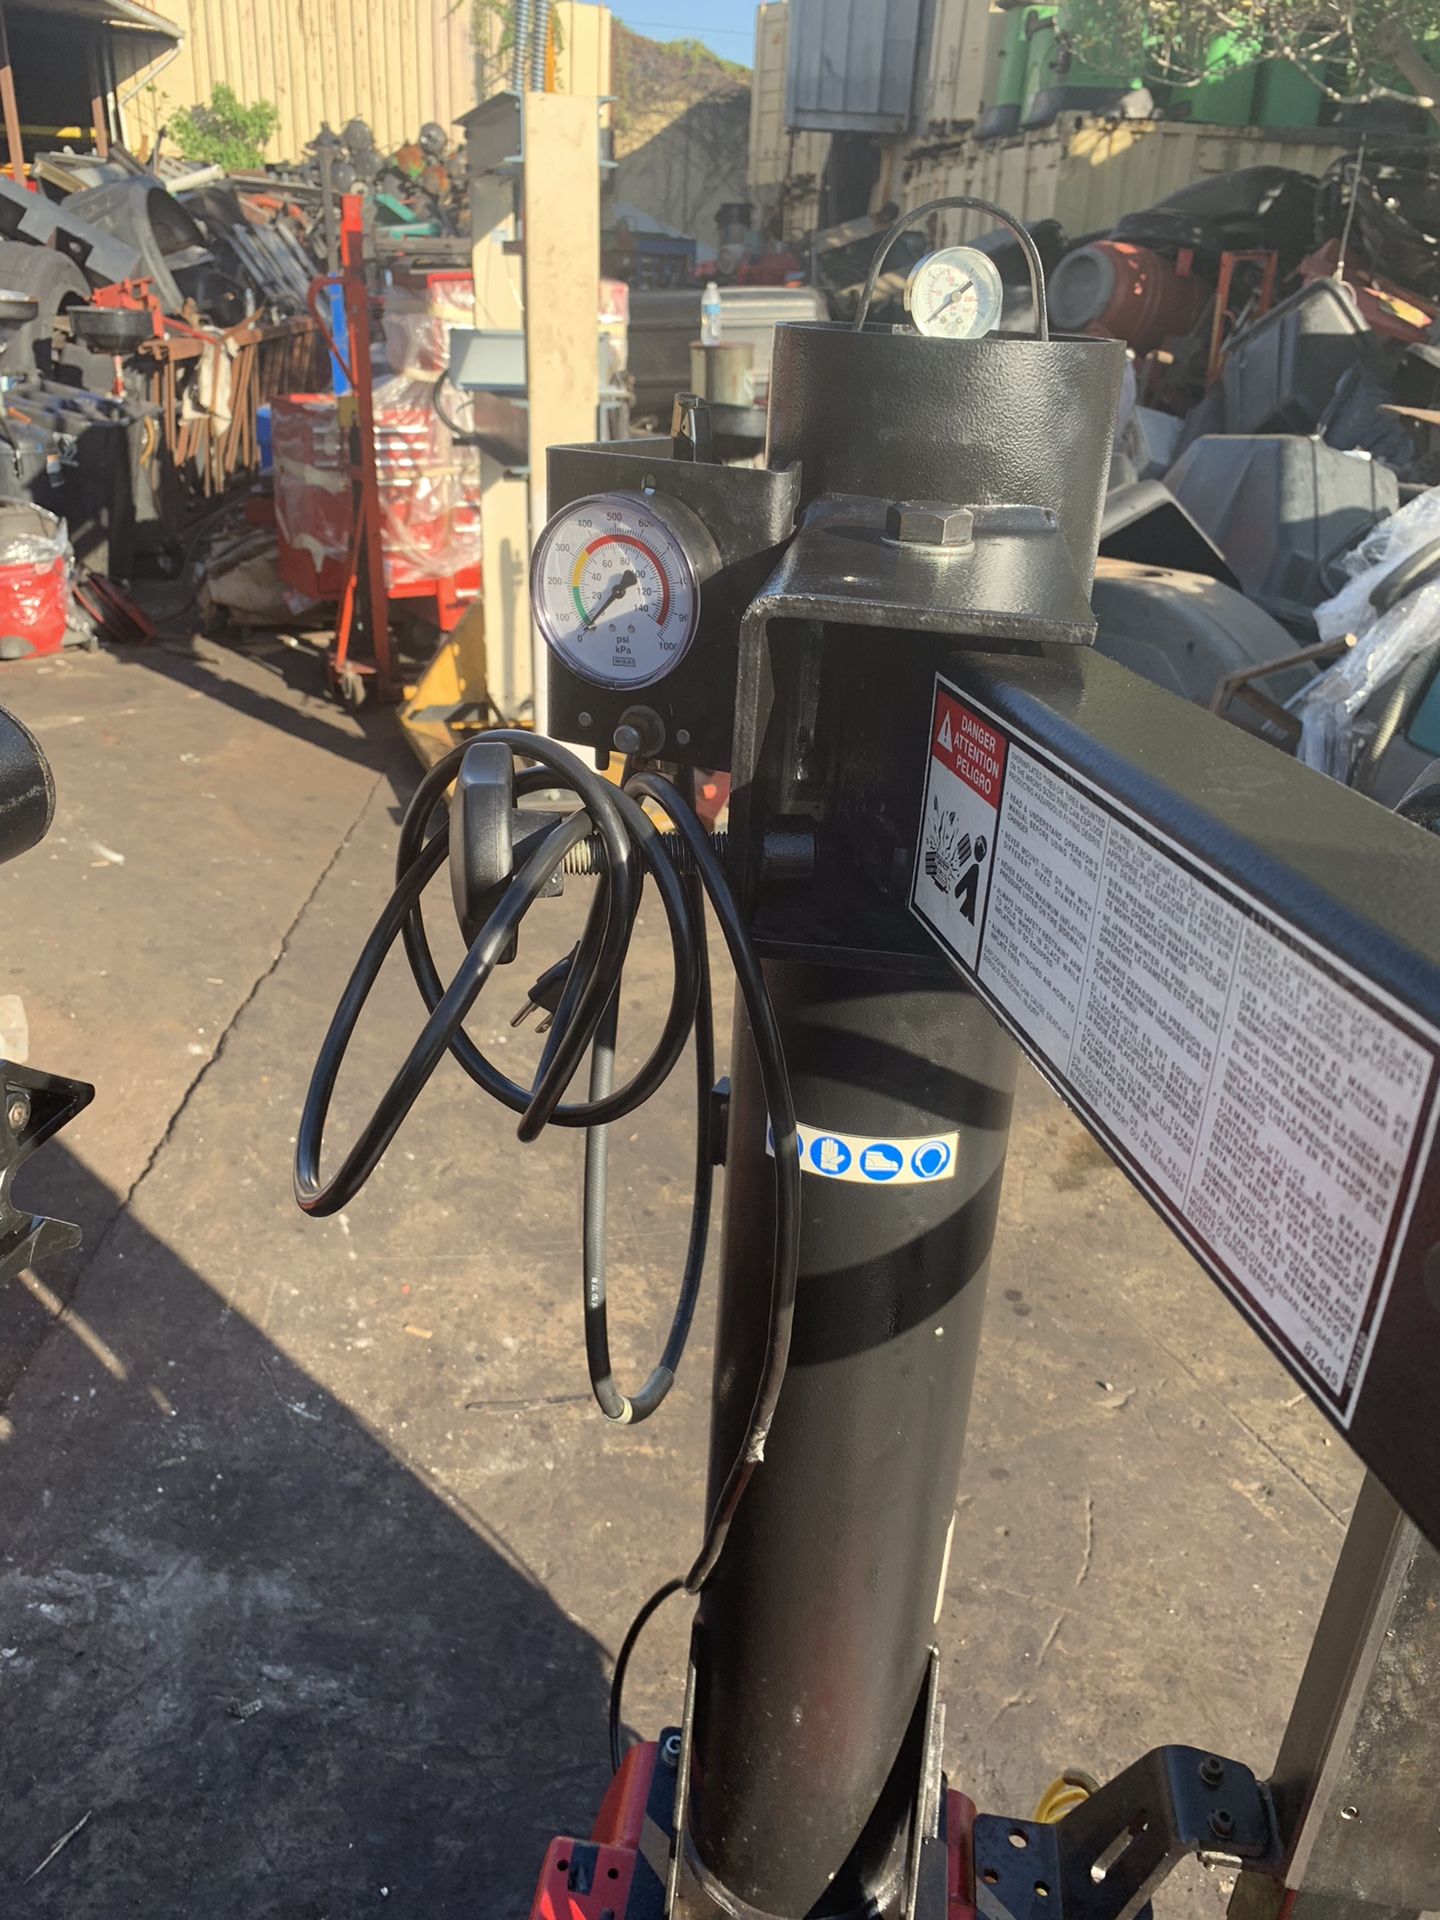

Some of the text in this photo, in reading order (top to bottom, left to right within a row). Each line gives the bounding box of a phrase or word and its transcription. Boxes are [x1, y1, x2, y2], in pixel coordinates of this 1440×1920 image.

[606, 513, 622, 521] 500
[578, 519, 592, 528] 400
[555, 544, 570, 552] 300
[602, 559, 613, 568] 60
[620, 557, 630, 566] 80
[548, 577, 562, 585] 200
[592, 573, 602, 582] 40
[592, 592, 602, 600] 20
[637, 587, 652, 596] 120
[634, 604, 649, 612] 140
[556, 613, 570, 622] 100
[577, 634, 583, 643] 0
[616, 636, 630, 646] psi
[615, 646, 632, 655] kPa
[961, 715, 996, 754] DANGER
[954, 732, 1000, 779] ATTENTION
[956, 754, 992, 794] PELIGRO
[1002, 839, 1031, 871] DIFFERENT
[1033, 866, 1051, 889] SIZED
[1004, 829, 1019, 850] NEVER
[1020, 844, 1039, 867] MOUNT
[1040, 861, 1052, 879] TIRE
[1064, 882, 1075, 899] RIM
[1077, 893, 1092, 914] WITH
[1107, 876, 1123, 896] BIEN
[1124, 890, 1155, 923] PRENDRE
[1157, 917, 1214, 971] CONNAISSANCE
[1110, 919, 1133, 946] JAMAIS
[1133, 939, 1160, 970] MONTER
[1169, 971, 1189, 995] PNEU
[1188, 987, 1204, 1009] SUR
[1204, 1001, 1220, 1023] UNE
[1104, 954, 1126, 981] JAMAIS
[1126, 974, 1158, 1011] DEPASSER
[1167, 1013, 1202, 1052] PRESSION
[1110, 1000, 1139, 1035] MACHINE
[1154, 1043, 1168, 1064] EST
[1082, 1023, 1116, 1065] TOUJOURS
[1119, 1061, 1151, 1102] UTILISER
[1169, 1114, 1194, 1148] TUYAU
[1303, 1340, 1339, 1387] 87445
